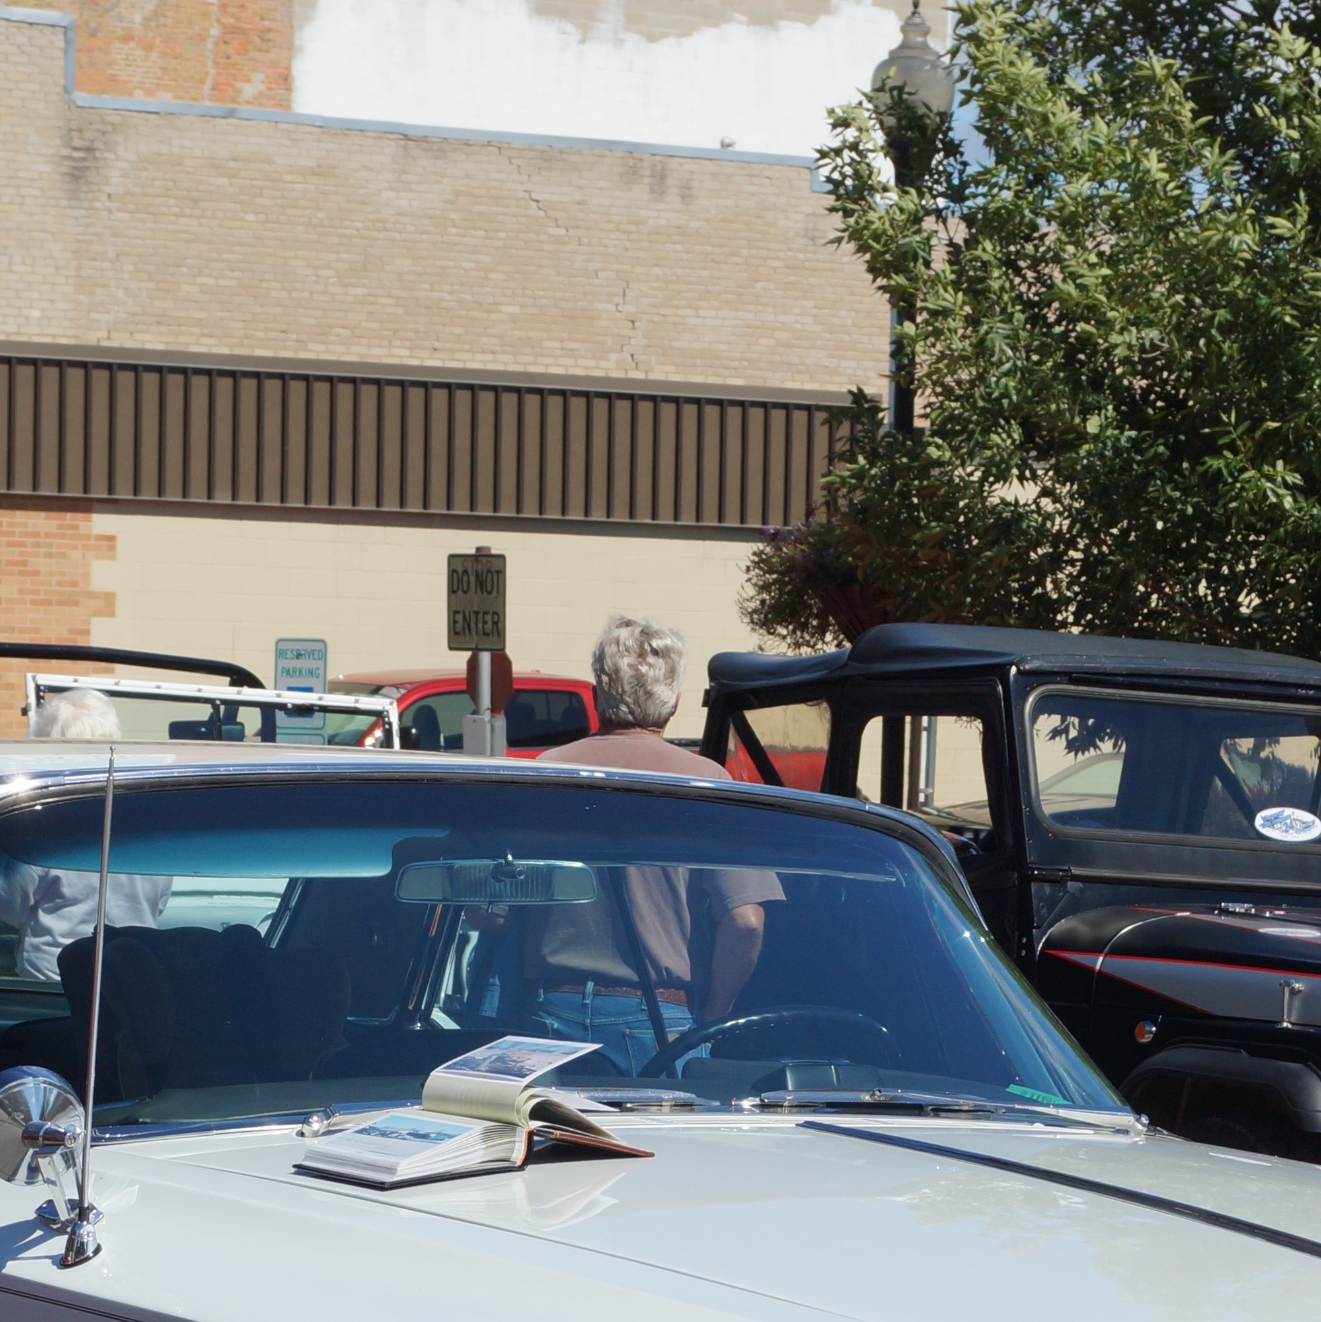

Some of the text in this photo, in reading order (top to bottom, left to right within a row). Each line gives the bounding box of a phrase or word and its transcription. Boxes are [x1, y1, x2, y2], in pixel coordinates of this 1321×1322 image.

[451, 569, 502, 595] DO NOT
[452, 610, 501, 637] ENTER
[278, 648, 324, 661] RESERVED
[280, 666, 321, 679] PARKING
